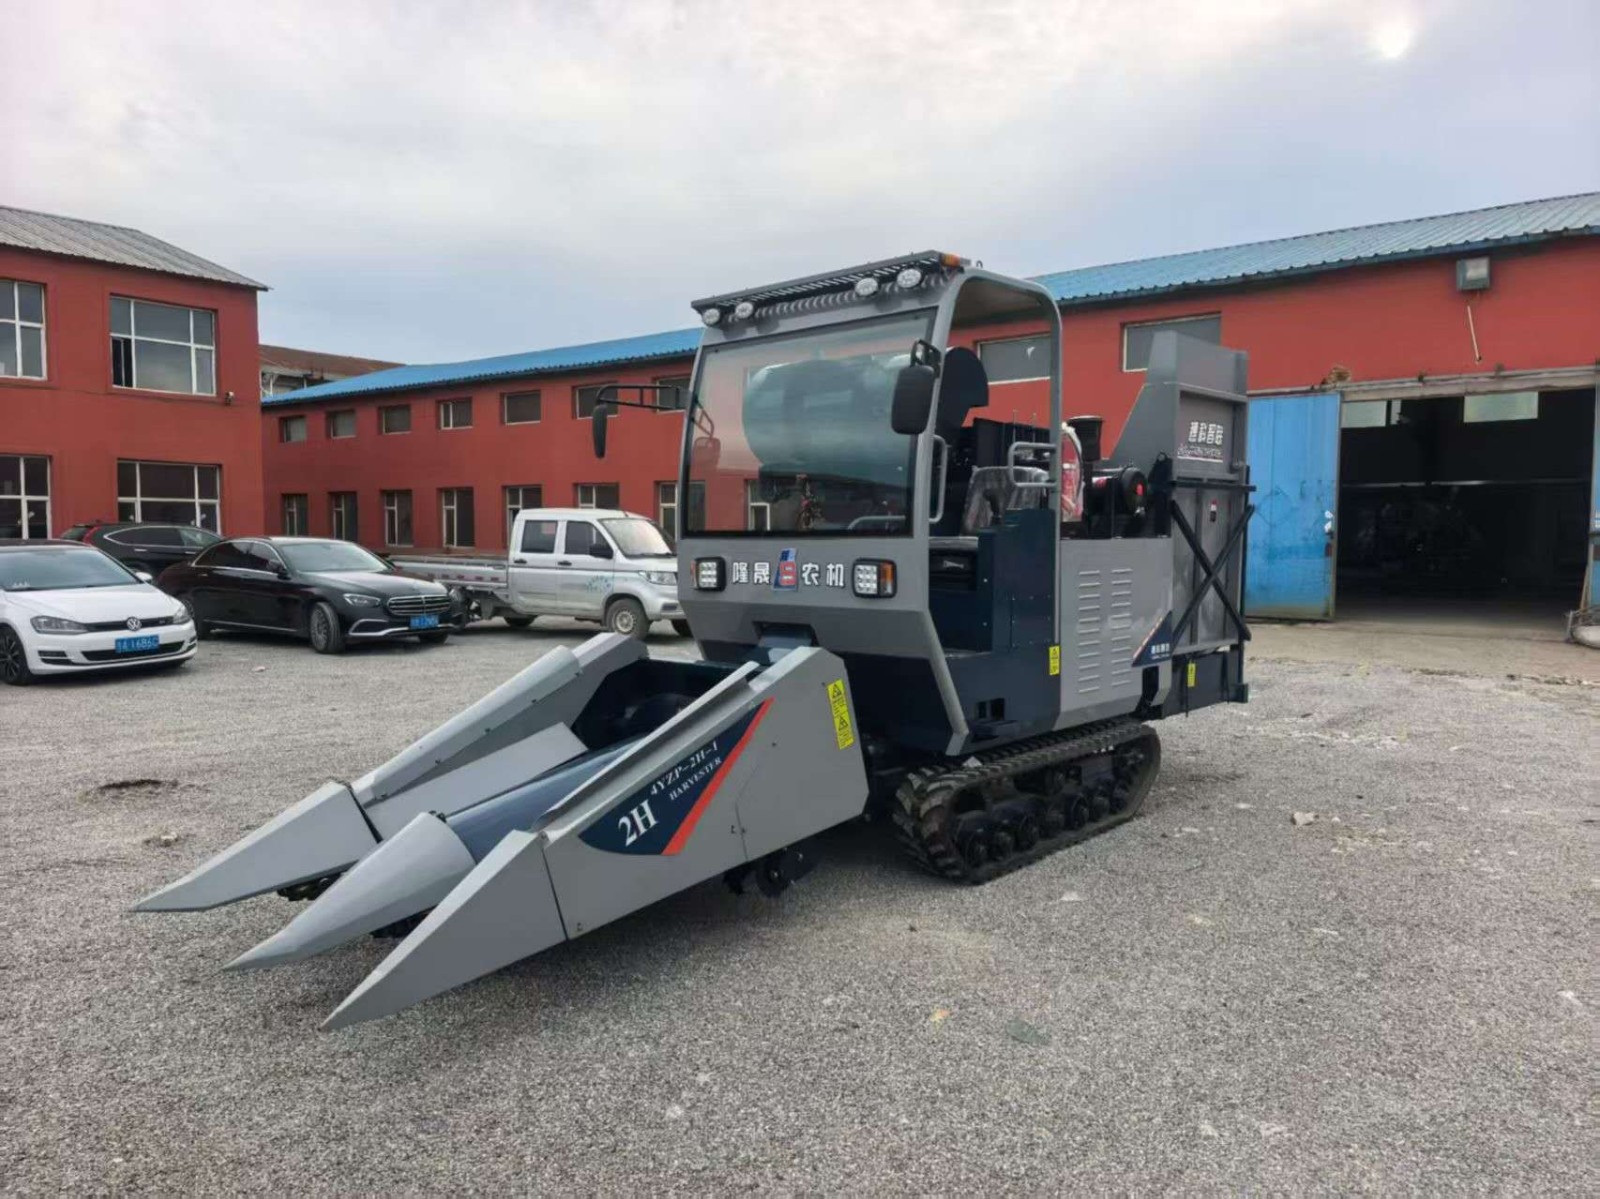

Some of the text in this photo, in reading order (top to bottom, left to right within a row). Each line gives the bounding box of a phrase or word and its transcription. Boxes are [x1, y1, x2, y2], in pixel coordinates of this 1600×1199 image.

[732, 562, 844, 586] 隆晟 农机
[669, 756, 722, 801] HARVESTER
[617, 799, 659, 847] 2H
